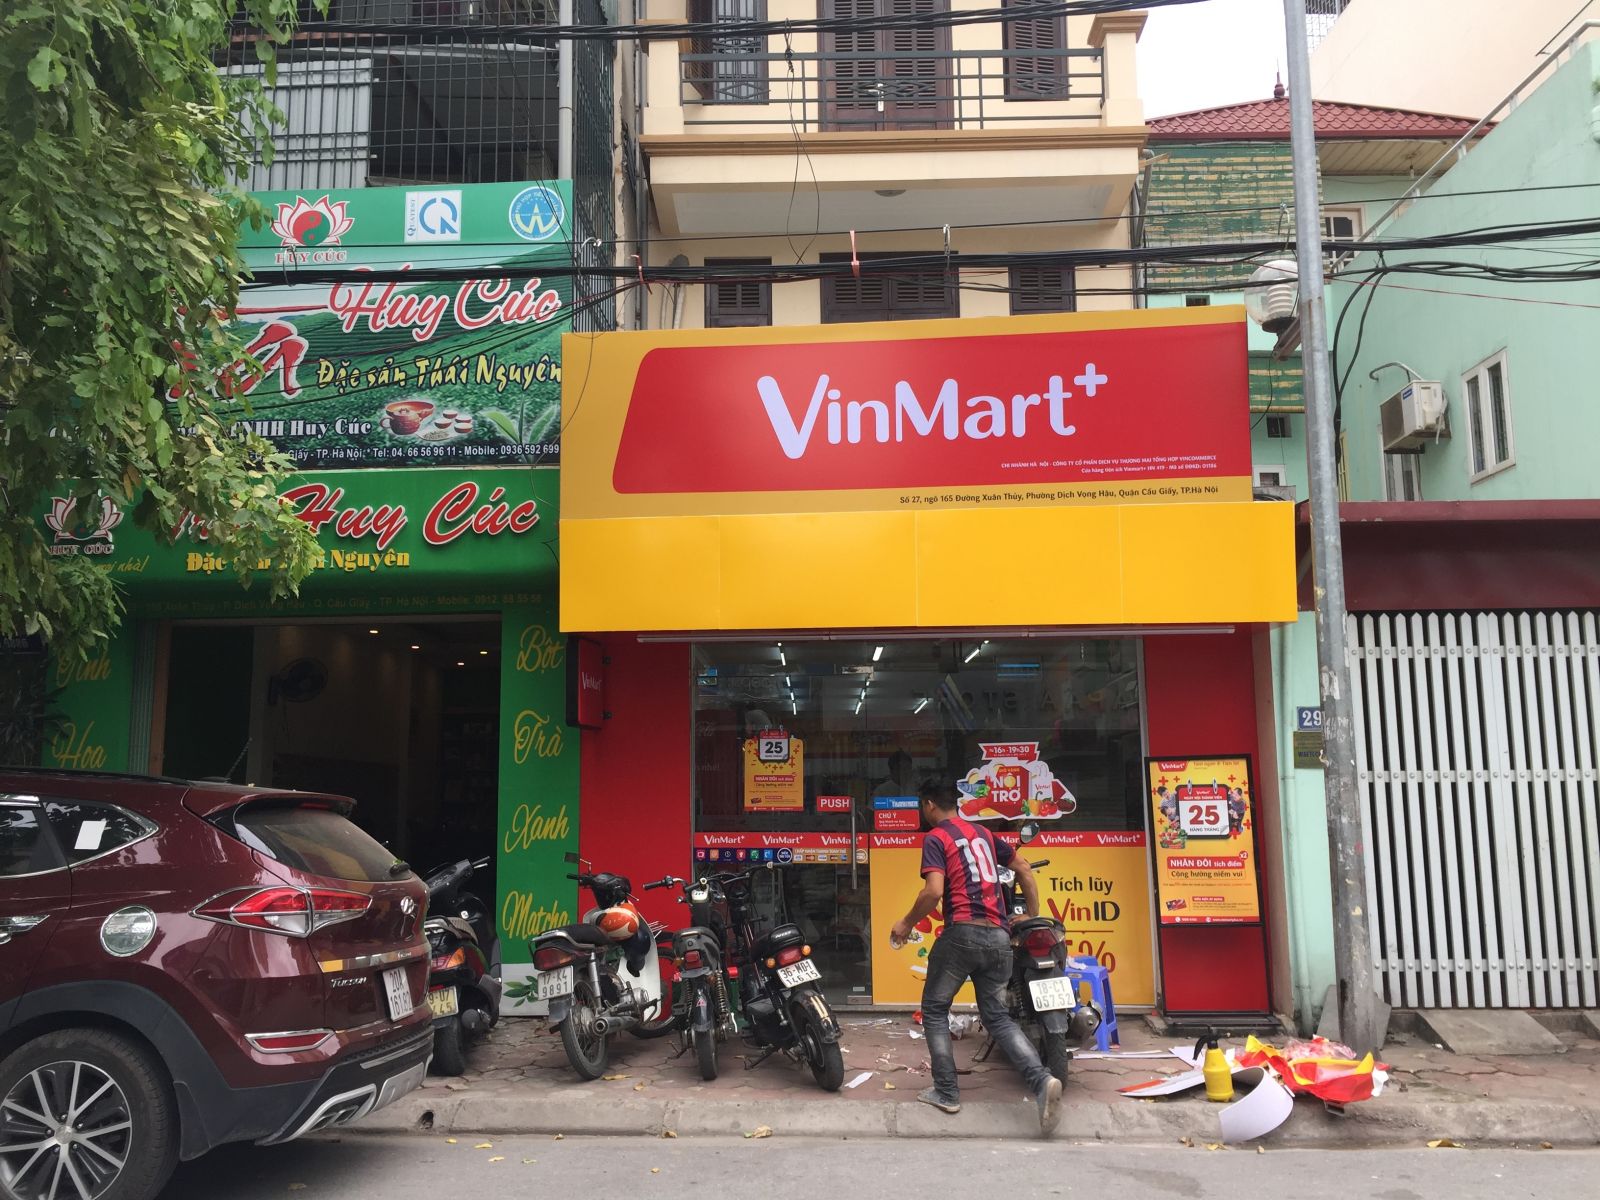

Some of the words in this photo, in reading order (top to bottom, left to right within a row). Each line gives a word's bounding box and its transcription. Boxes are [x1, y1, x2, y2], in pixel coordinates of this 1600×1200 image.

[275, 251, 310, 264] HUY
[312, 249, 347, 263] CÚC
[329, 264, 451, 343] Huy
[454, 266, 562, 330] Cúc
[316, 356, 360, 396] Đặc
[366, 356, 405, 389] sản
[416, 353, 469, 390] Thái
[476, 351, 561, 394] Nguyên
[756, 362, 1108, 459] VinMart+
[290, 420, 330, 439] Huy
[334, 416, 372, 436] Cúc
[373, 448, 390, 458] Tel:
[407, 447, 419, 457] 66
[420, 447, 431, 457] 56
[433, 446, 445, 456] 96
[446, 446, 456, 455] 11
[464, 445, 499, 456] Mobile:
[501, 444, 523, 454] 0936
[525, 444, 540, 454] 592
[543, 443, 560, 454] 699
[900, 495, 910, 504] Số
[912, 496, 922, 504] 27,
[924, 495, 938, 505] ngõ
[941, 494, 953, 502] 165
[955, 494, 980, 504] Đường
[982, 493, 1002, 501] Xuân
[1026, 491, 1056, 500] Phường
[1057, 490, 1075, 499] Dịch
[1076, 490, 1097, 499] Vọng
[1098, 489, 1116, 498] Hậu,
[1118, 488, 1140, 498] Quận
[1141, 487, 1157, 496] Cầu
[1159, 486, 1179, 497] Giấy,
[1204, 486, 1219, 494] Nội
[279, 483, 408, 550] Huy
[423, 481, 540, 545] Cúc
[187, 551, 228, 575] Đặc
[330, 548, 411, 572] Nguyên
[516, 624, 565, 674] Bột
[1302, 709, 1322, 727] 29
[52, 720, 108, 769] Hoa
[514, 709, 564, 765] Trà
[765, 741, 784, 754] 25
[820, 798, 850, 808] PUSH
[991, 787, 1021, 804] TRỢ
[1188, 804, 1220, 825] 25
[504, 803, 570, 853] Xanh
[955, 837, 998, 884] 10
[1170, 858, 1195, 867] NHÂN
[1196, 857, 1212, 867] ĐÔI
[1049, 876, 1083, 891] Tích
[1089, 876, 1113, 895] lũy
[1171, 870, 1189, 878] Cộng
[502, 890, 570, 940] Matcha
[1046, 898, 1120, 924] VinID
[542, 981, 568, 998] 9891
